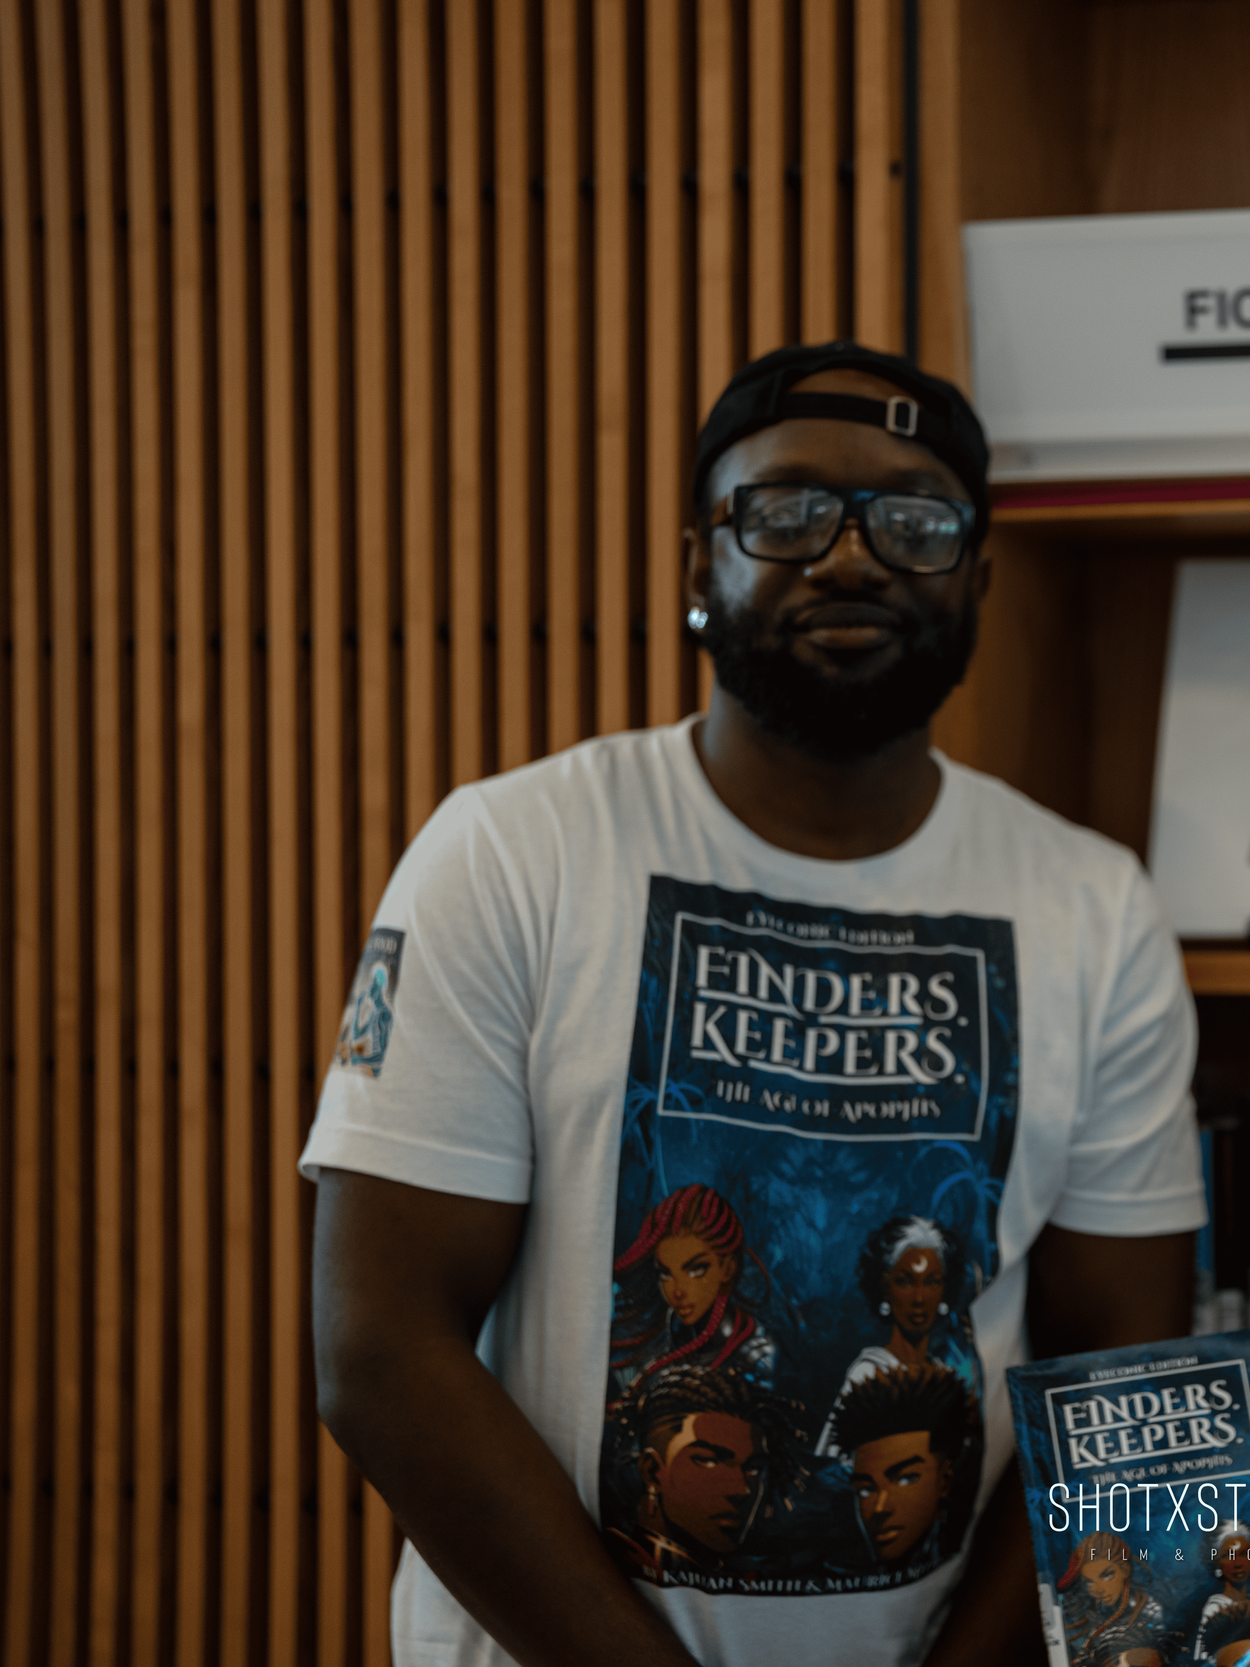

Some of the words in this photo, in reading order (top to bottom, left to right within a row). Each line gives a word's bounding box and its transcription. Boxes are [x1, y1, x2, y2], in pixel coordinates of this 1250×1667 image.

[696, 944, 969, 1028] FINDERS.
[689, 1000, 967, 1085] KEEPERS.
[1062, 1379, 1241, 1431] FINDERS.
[1067, 1412, 1246, 1469] KEEPERS.
